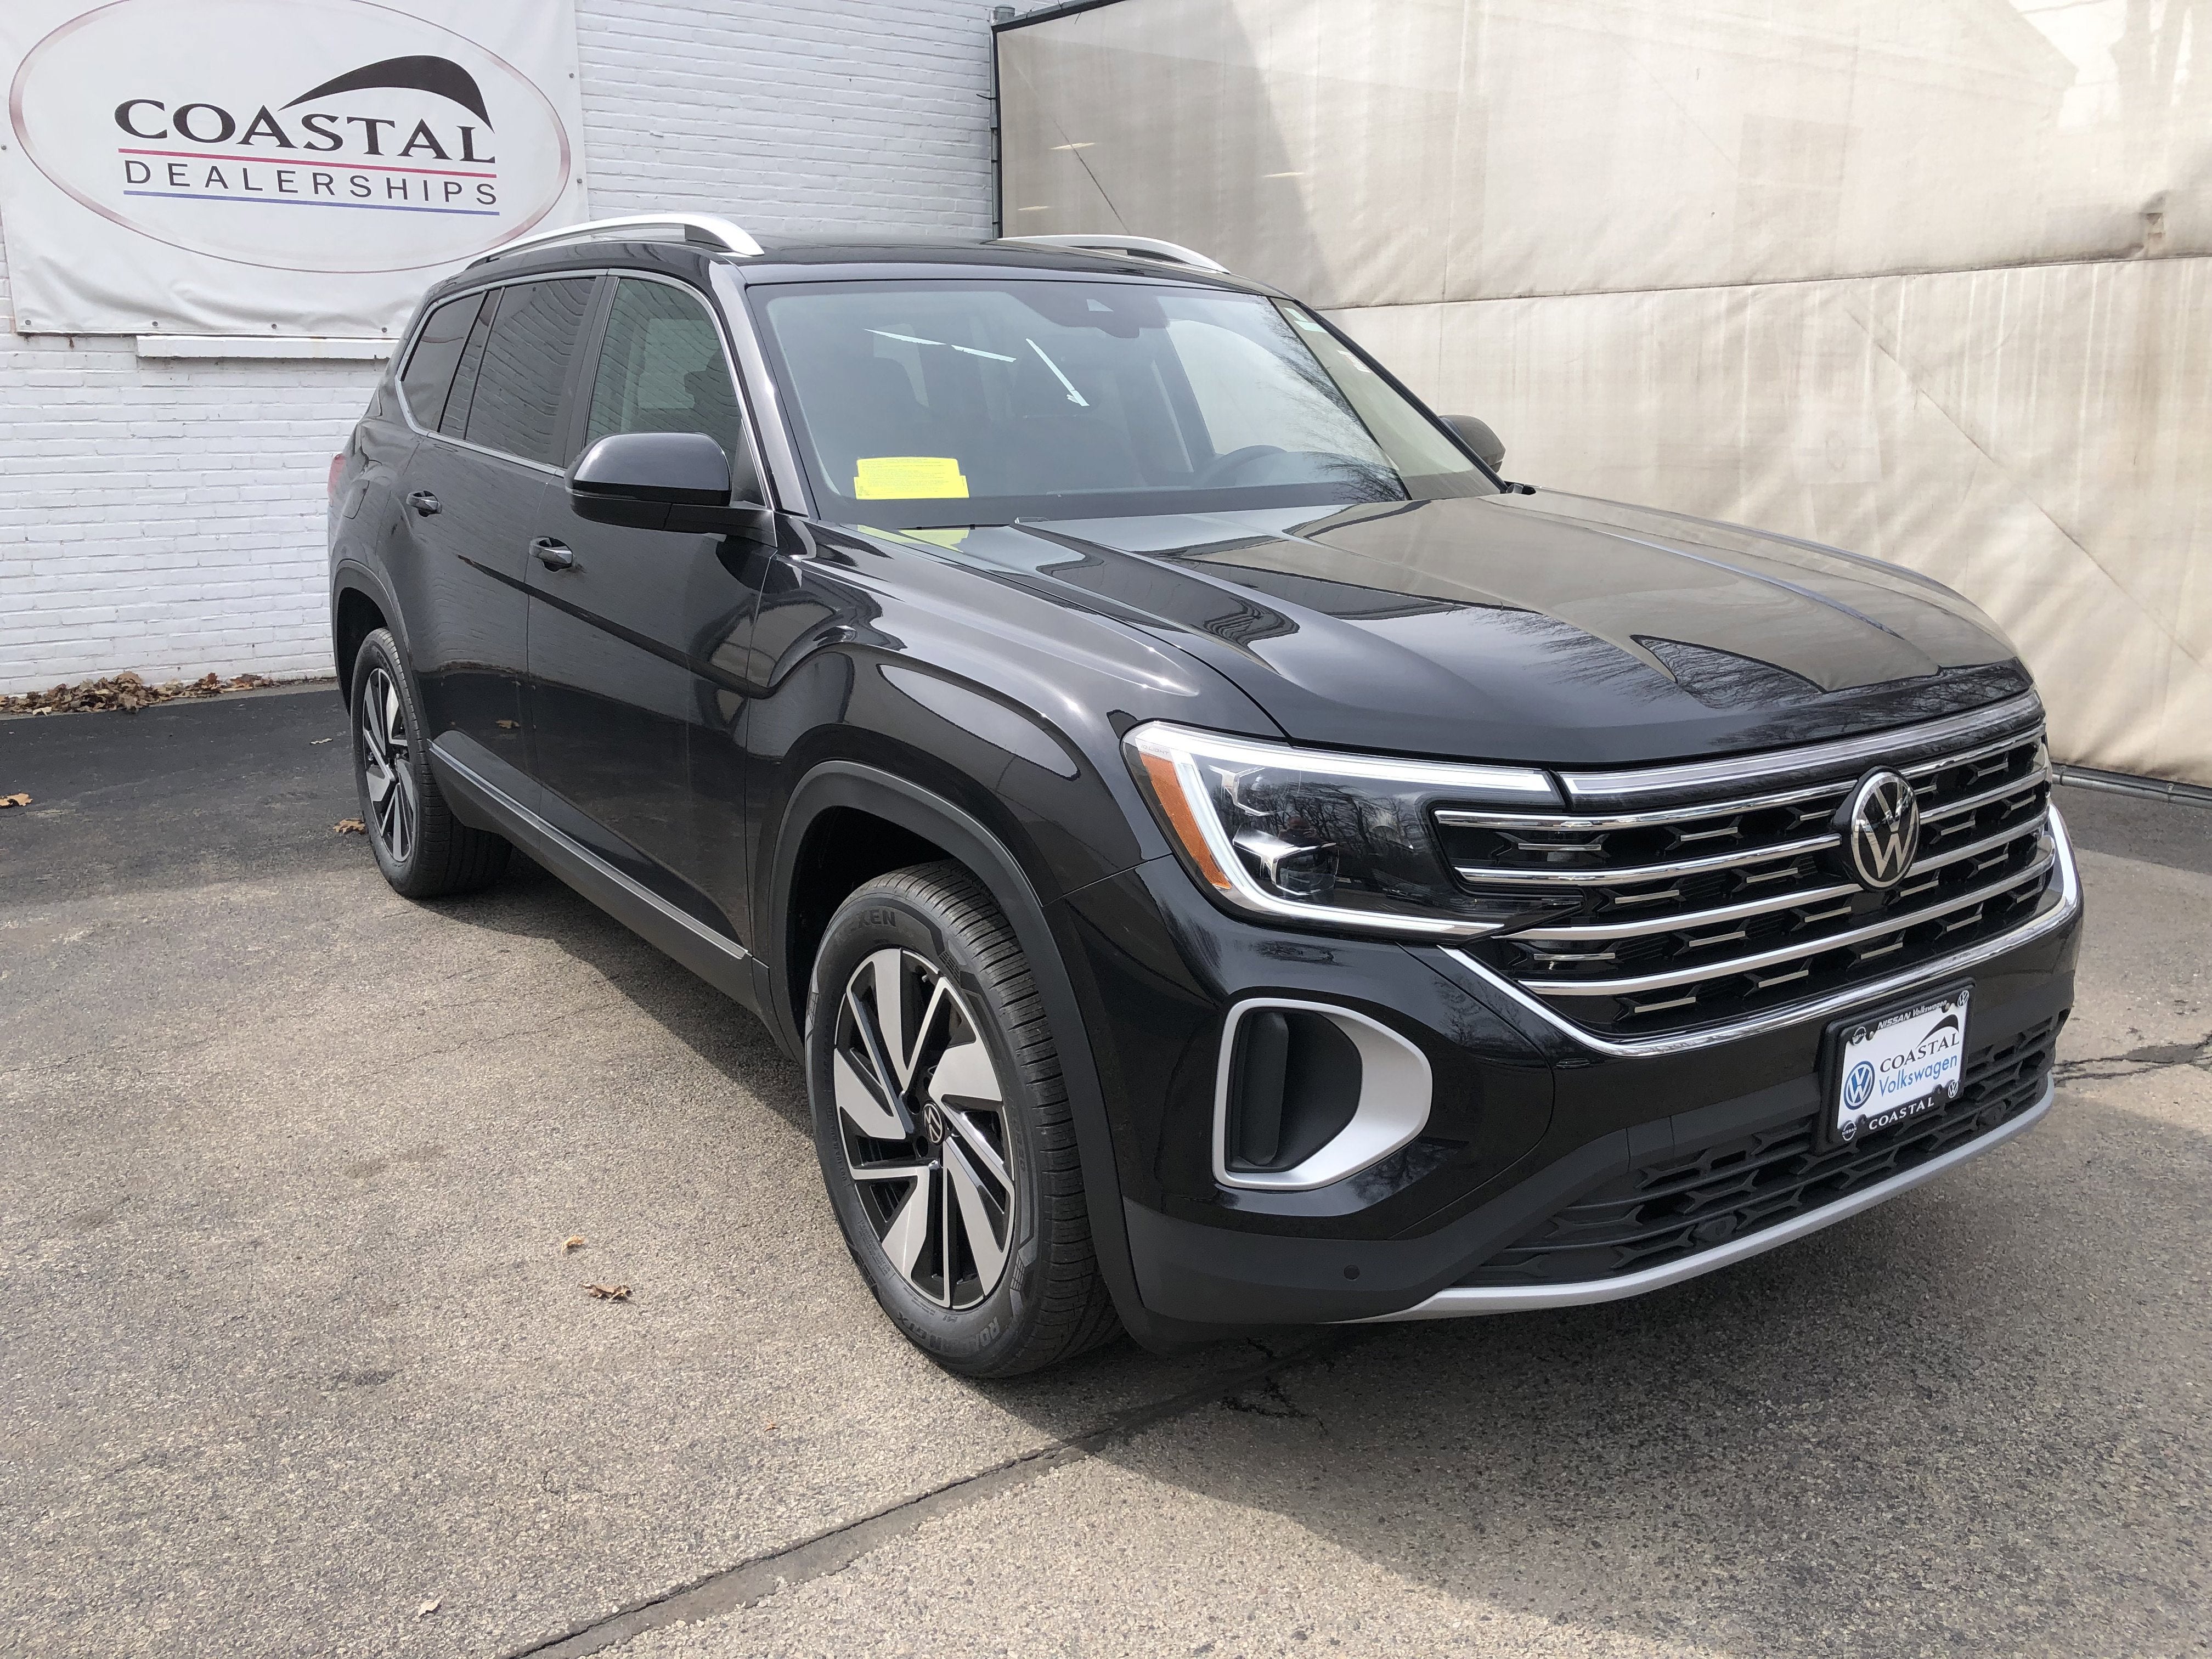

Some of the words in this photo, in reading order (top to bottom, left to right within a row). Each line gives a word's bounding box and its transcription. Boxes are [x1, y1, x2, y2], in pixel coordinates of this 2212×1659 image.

[114, 99, 496, 163] COASTAL
[125, 160, 498, 206] DEALERSHIPS
[1877, 1012, 1911, 1030] NISSAN
[1912, 1000, 1947, 1017] Volkswagen
[1880, 1032, 1960, 1073] COASTAL
[1878, 1055, 1957, 1098] Volkswagen
[1869, 1097, 1934, 1131] COASTAL
